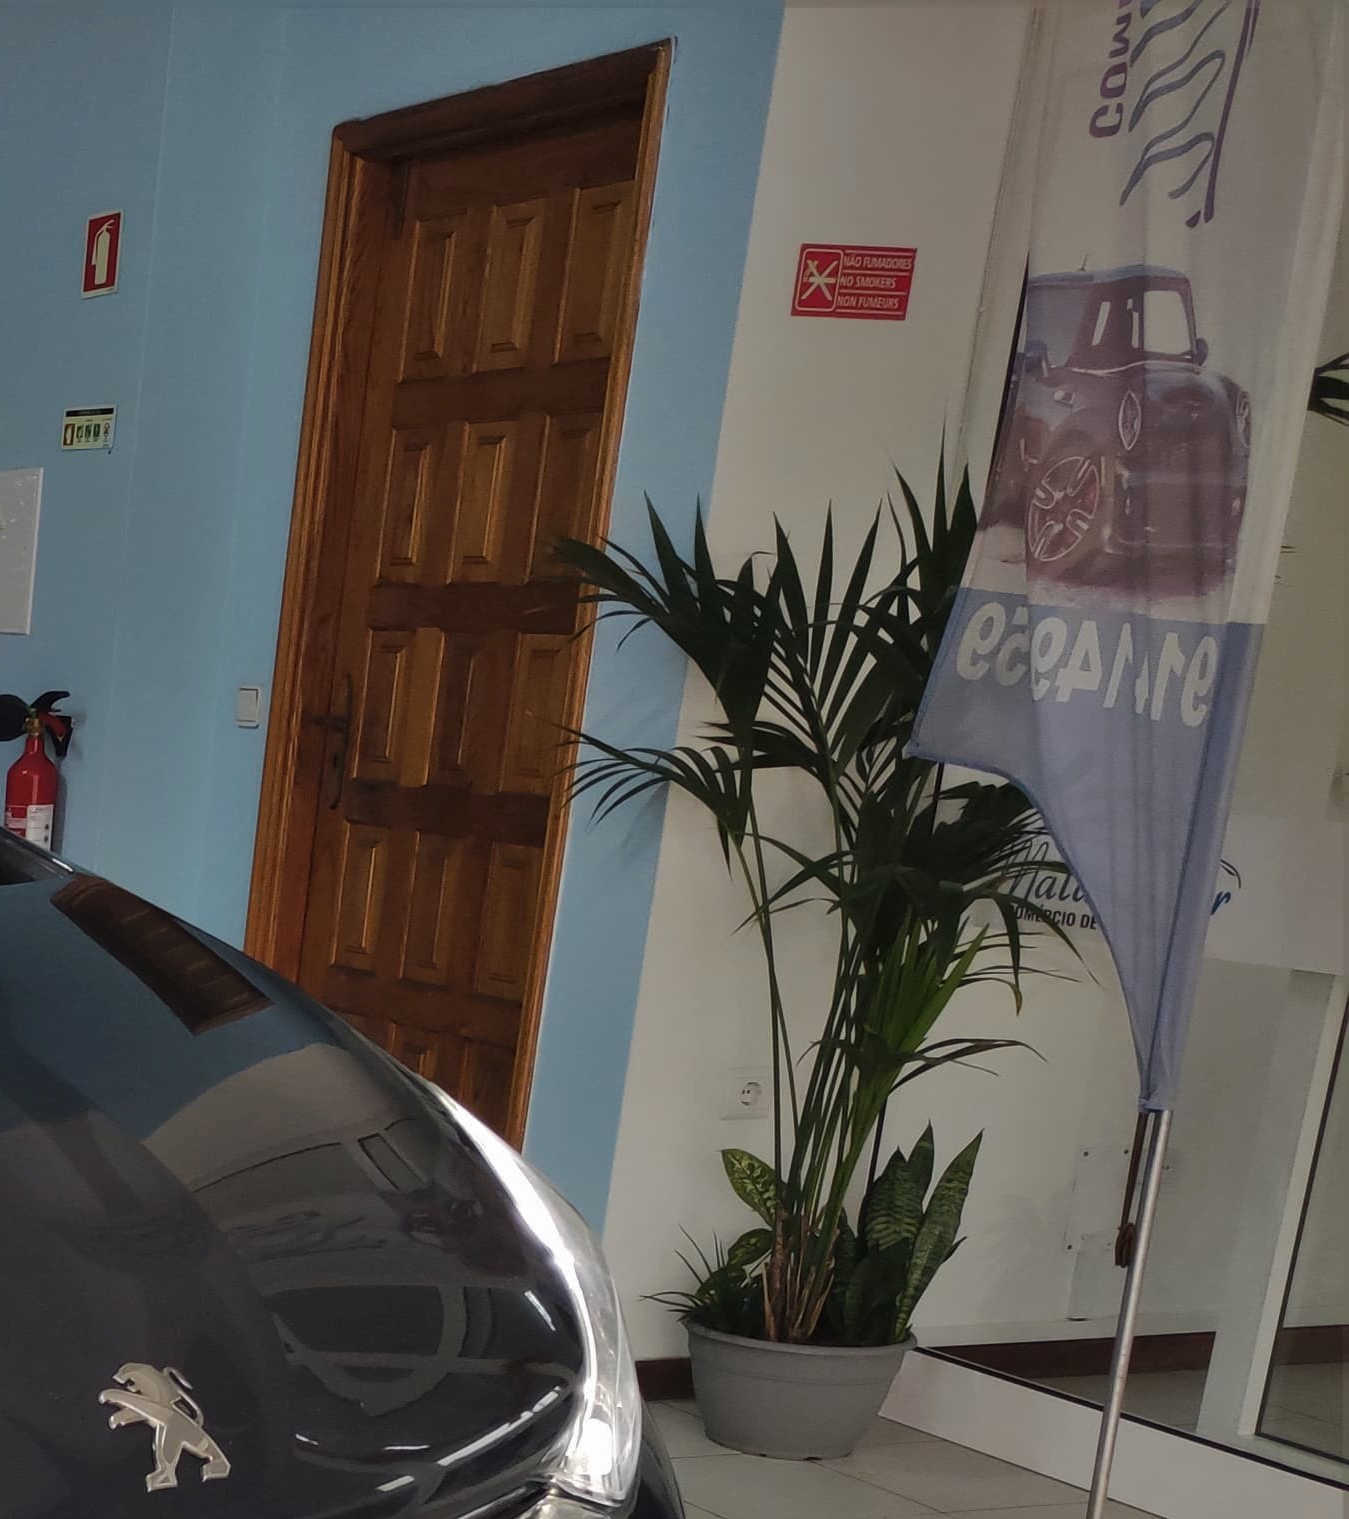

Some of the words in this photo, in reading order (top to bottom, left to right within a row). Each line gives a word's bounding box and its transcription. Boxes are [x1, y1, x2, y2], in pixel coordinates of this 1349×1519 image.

[843, 254, 862, 267] NÃO
[863, 256, 912, 269] FUMADORES
[839, 276, 854, 287] NO
[855, 276, 896, 289] SMOKERS
[836, 295, 856, 307] NON
[857, 297, 899, 309] FUMEURS
